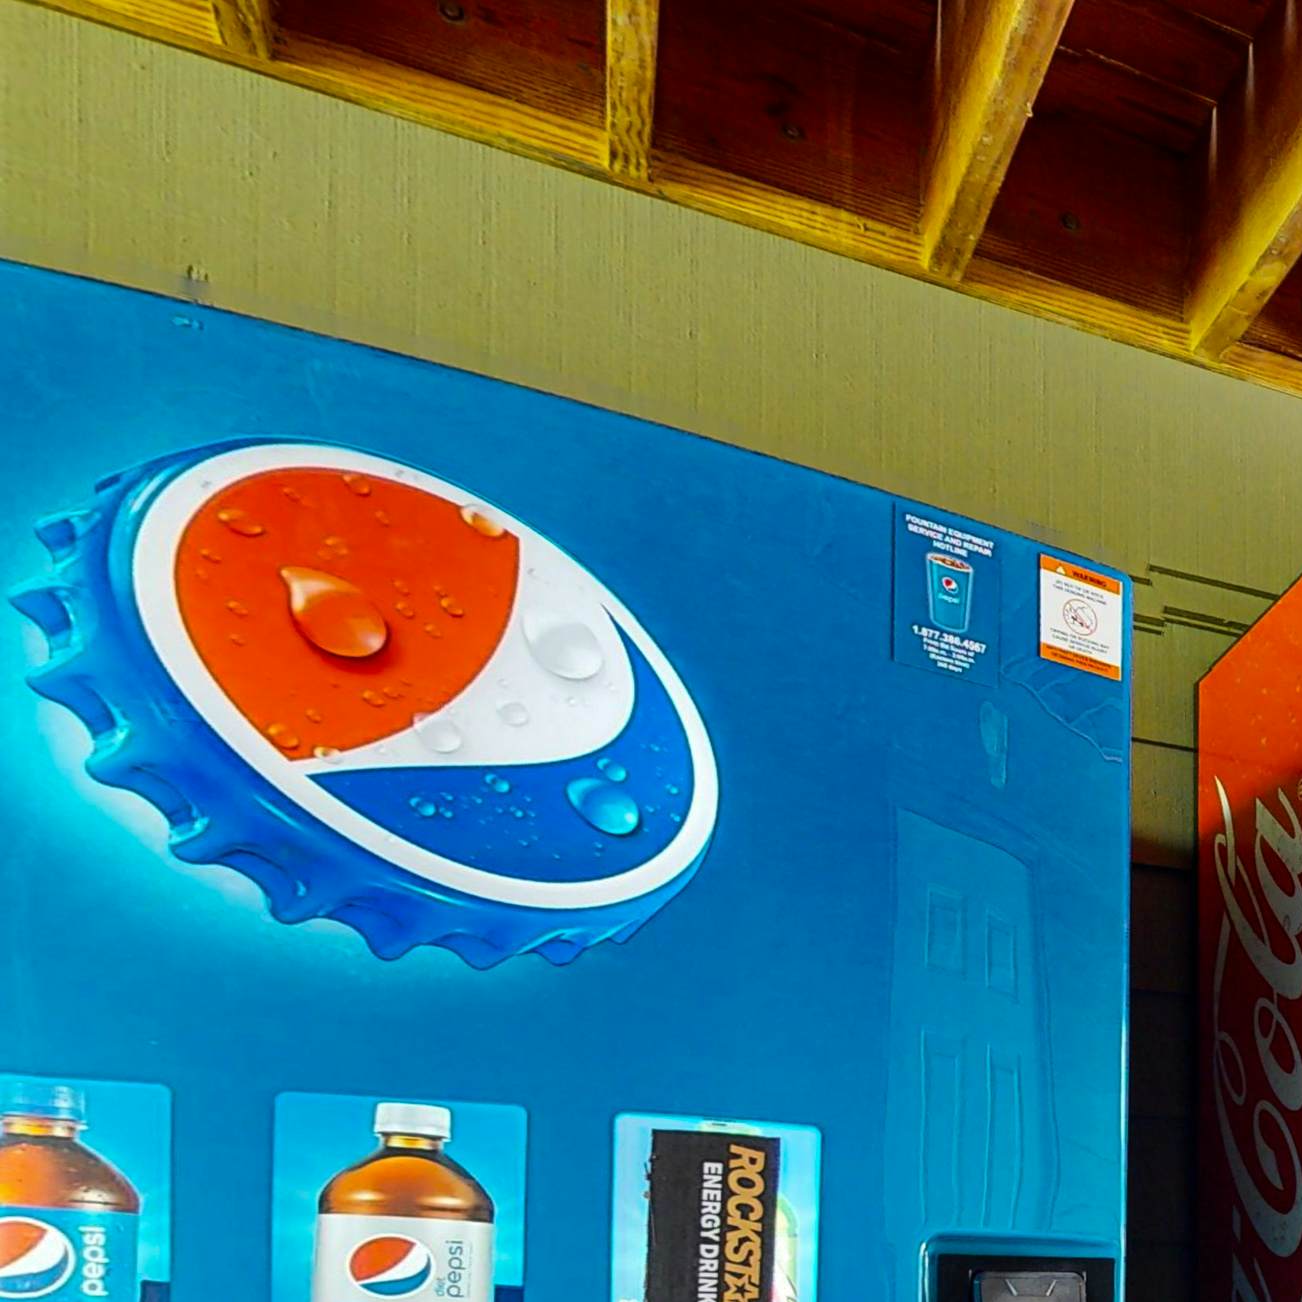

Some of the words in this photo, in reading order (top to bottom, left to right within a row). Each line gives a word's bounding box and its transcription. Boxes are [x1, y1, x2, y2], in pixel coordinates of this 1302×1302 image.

[700, 1161, 724, 1242] ENERGY
[77, 1225, 110, 1297] pepsi
[445, 1239, 467, 1298] pepsi
